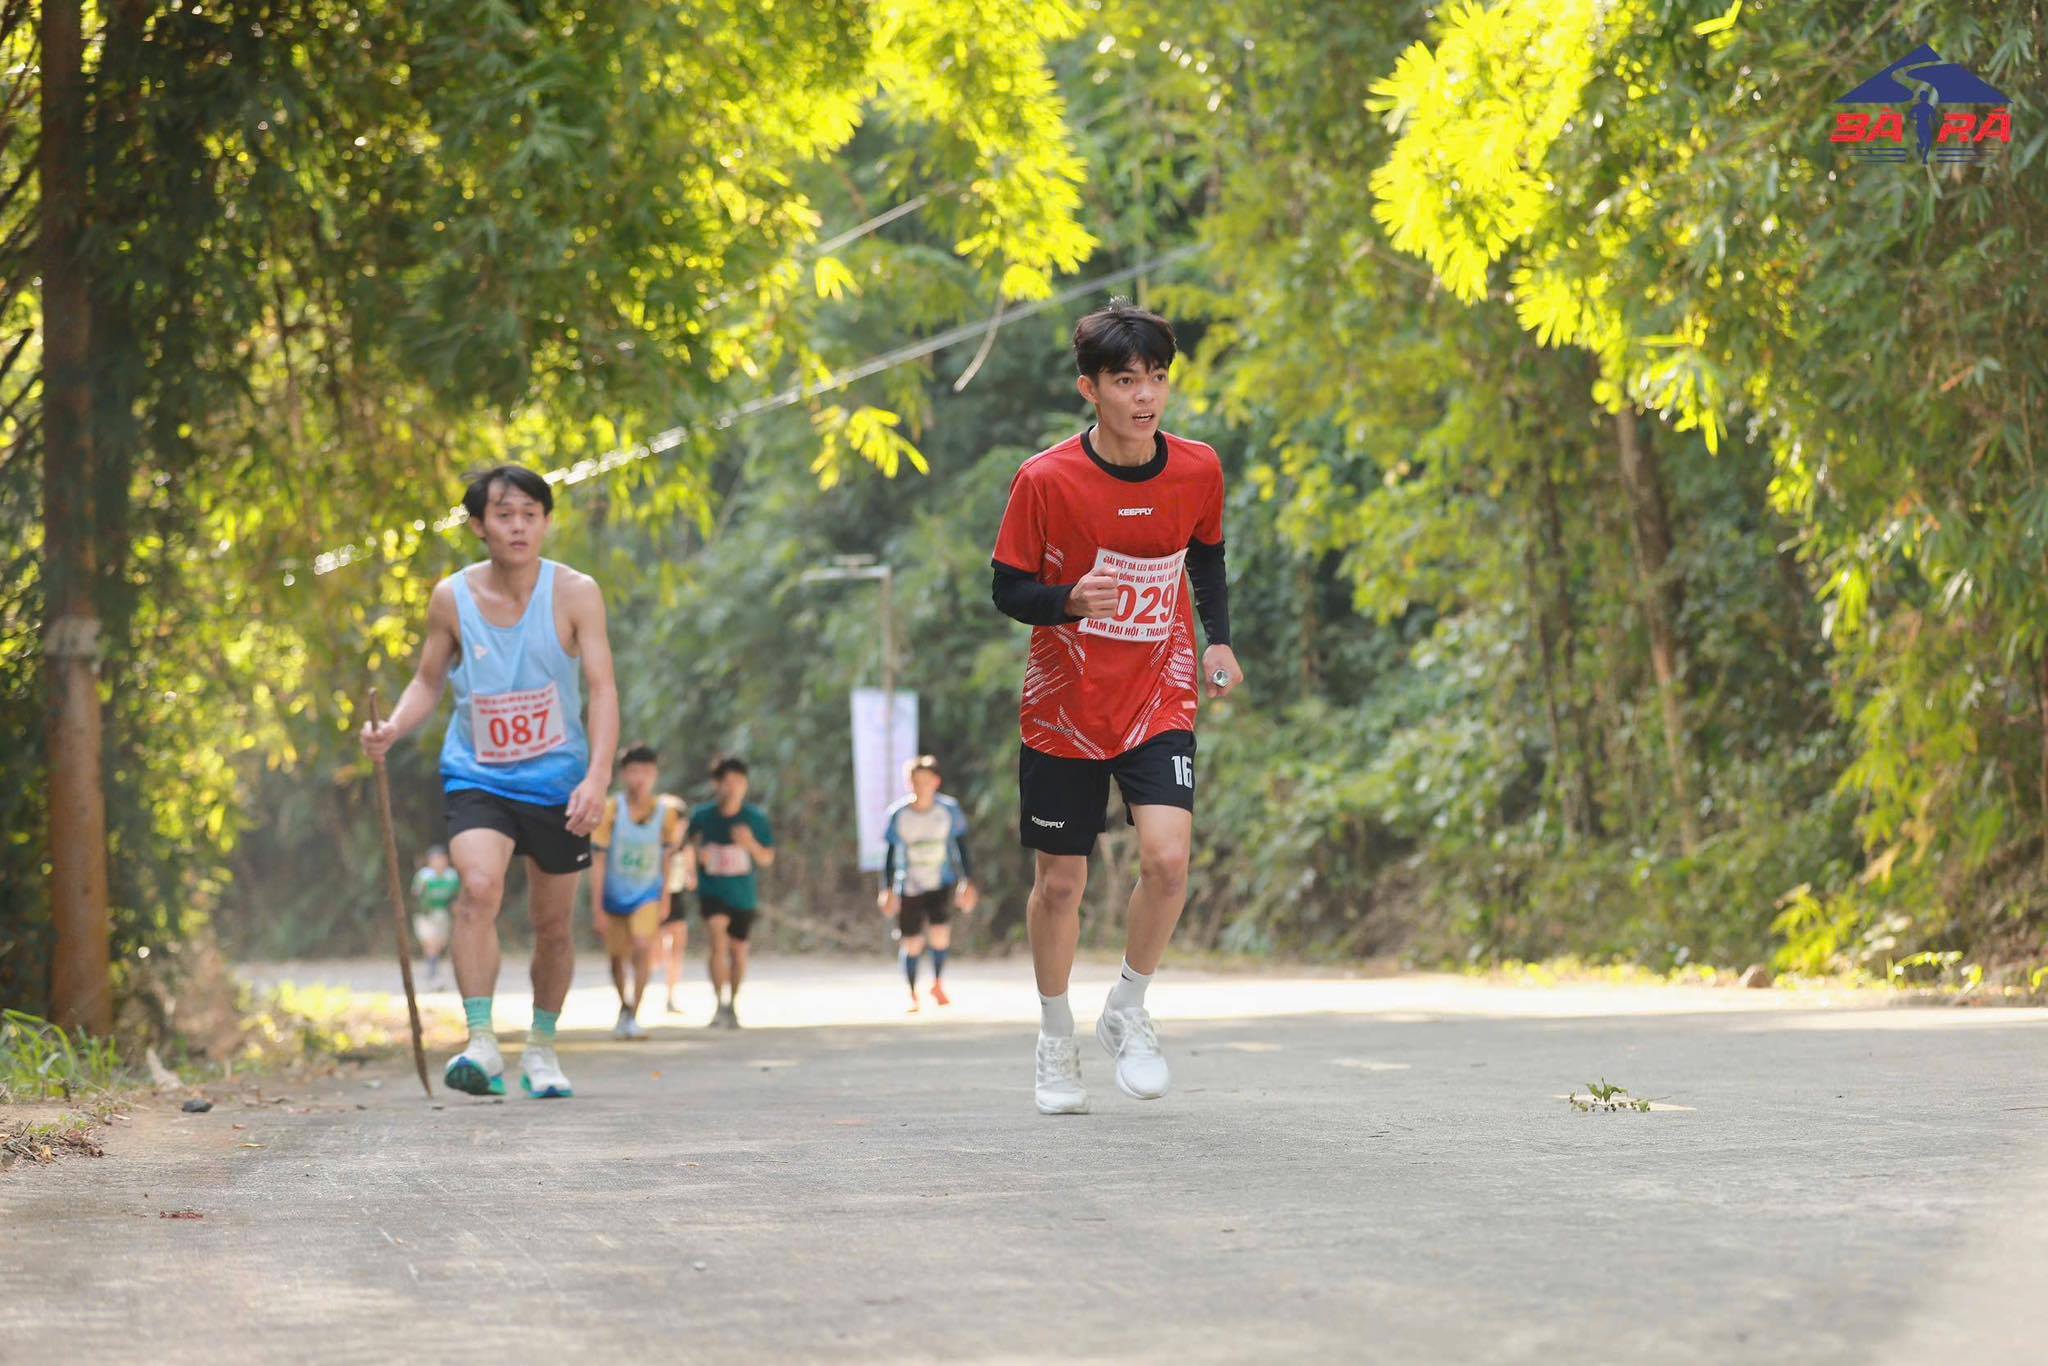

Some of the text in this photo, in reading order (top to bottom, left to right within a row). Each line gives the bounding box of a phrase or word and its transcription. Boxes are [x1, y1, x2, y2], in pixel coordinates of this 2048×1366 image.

[1112, 583, 1174, 624] 029
[489, 709, 549, 749] 087
[1171, 755, 1193, 789] 16
